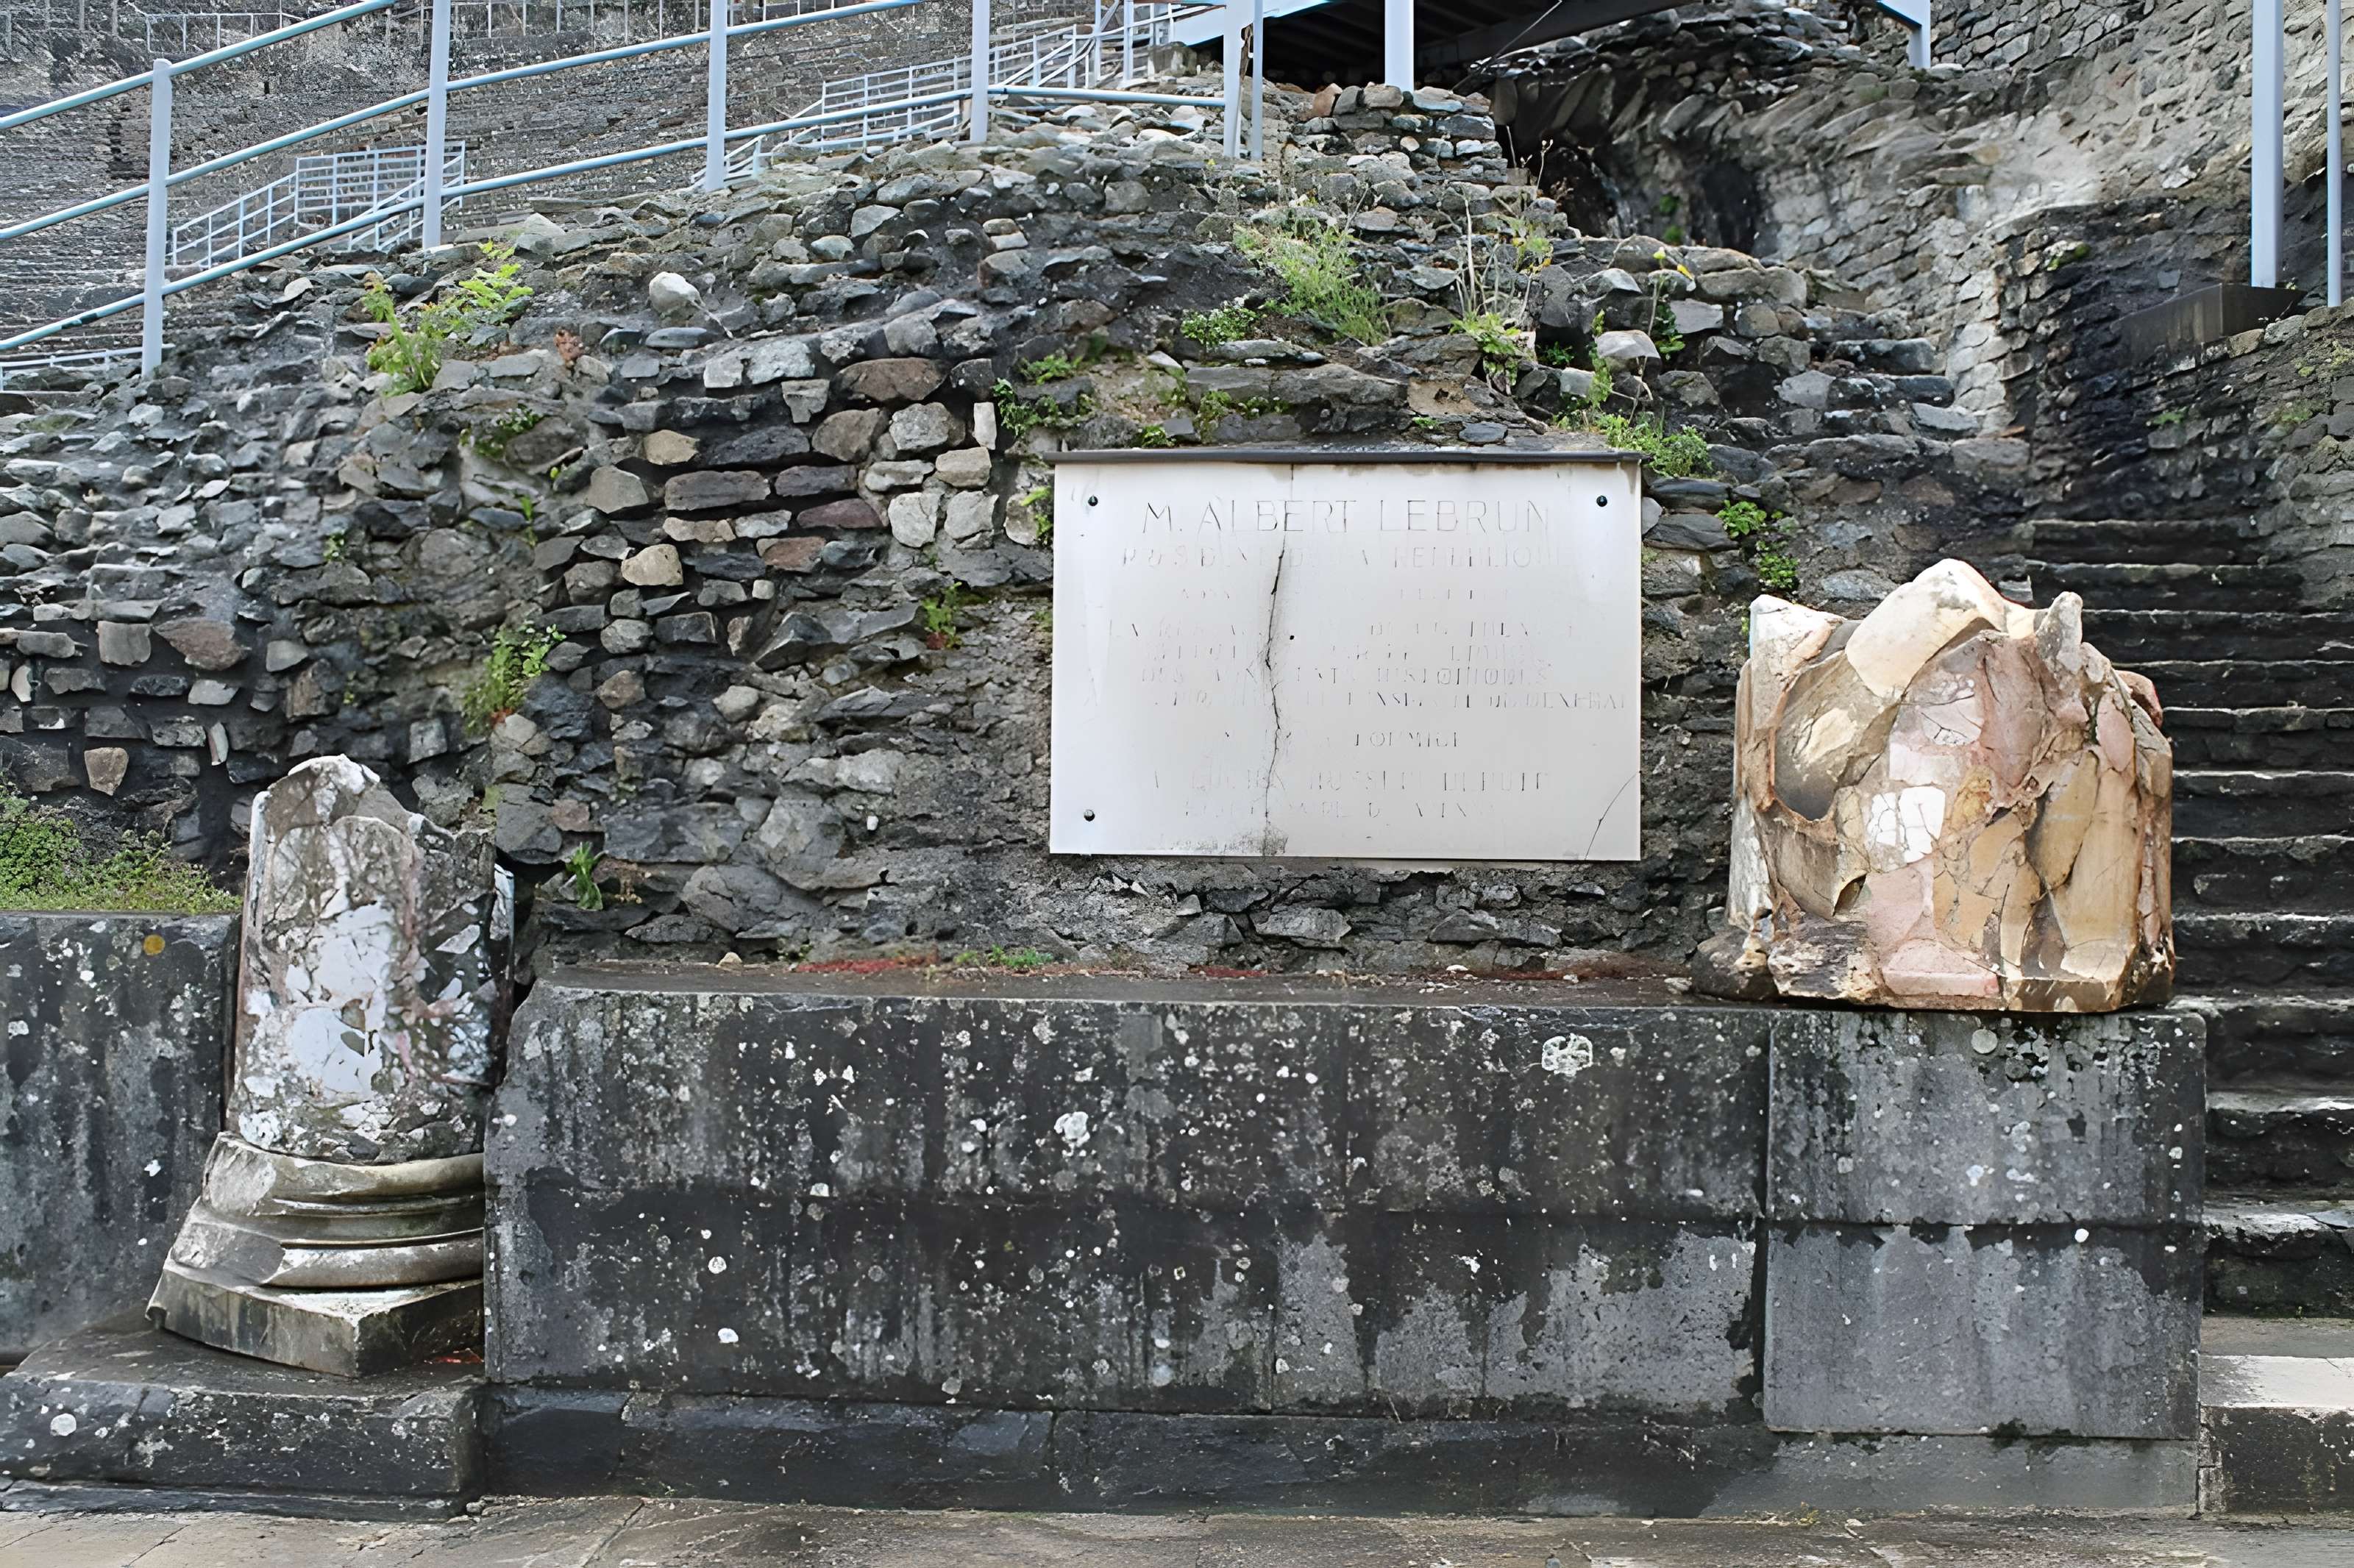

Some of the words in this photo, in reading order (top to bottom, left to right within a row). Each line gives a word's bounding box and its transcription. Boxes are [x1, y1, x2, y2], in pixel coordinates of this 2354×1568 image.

[1142, 501, 1183, 534] M.
[1197, 499, 1357, 534] ALBERT
[1379, 499, 1549, 535] LEBRUN
